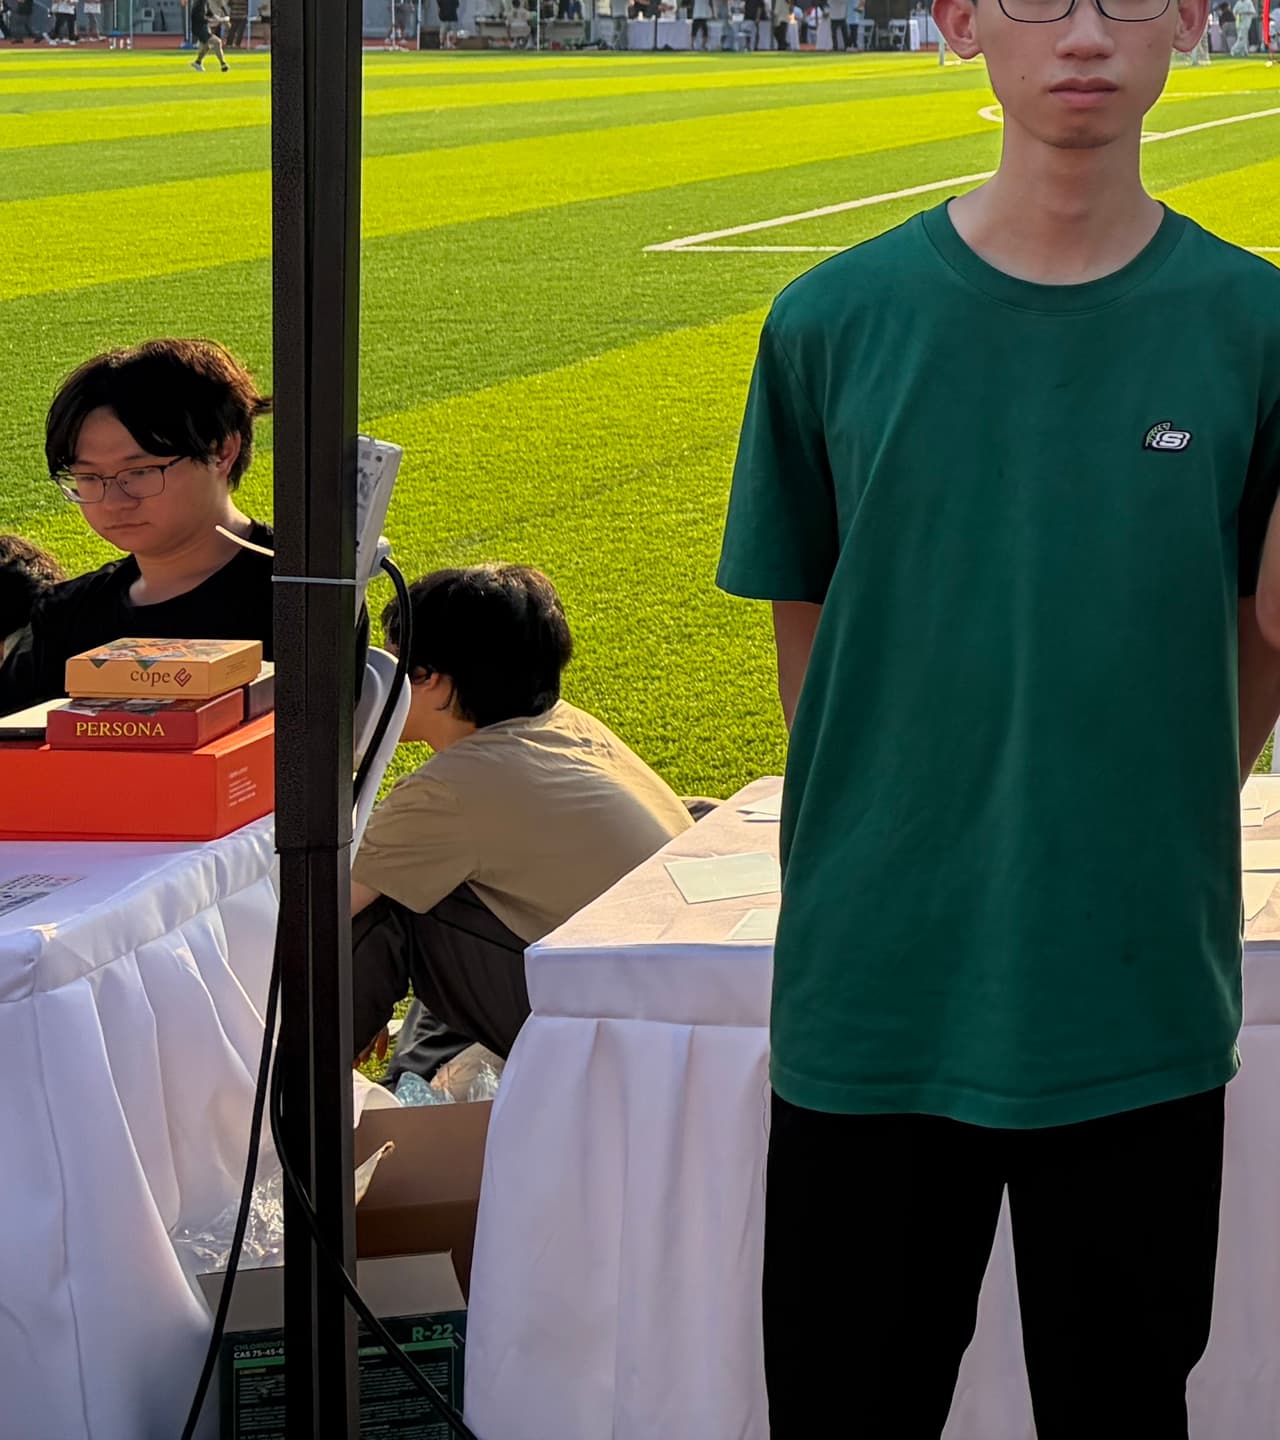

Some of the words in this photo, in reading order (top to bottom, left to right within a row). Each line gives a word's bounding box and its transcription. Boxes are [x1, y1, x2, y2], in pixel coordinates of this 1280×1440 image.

[130, 670, 170, 687] cope
[76, 722, 165, 737] PERSONA
[412, 1323, 454, 1342] R-22
[233, 1350, 251, 1358] CAS
